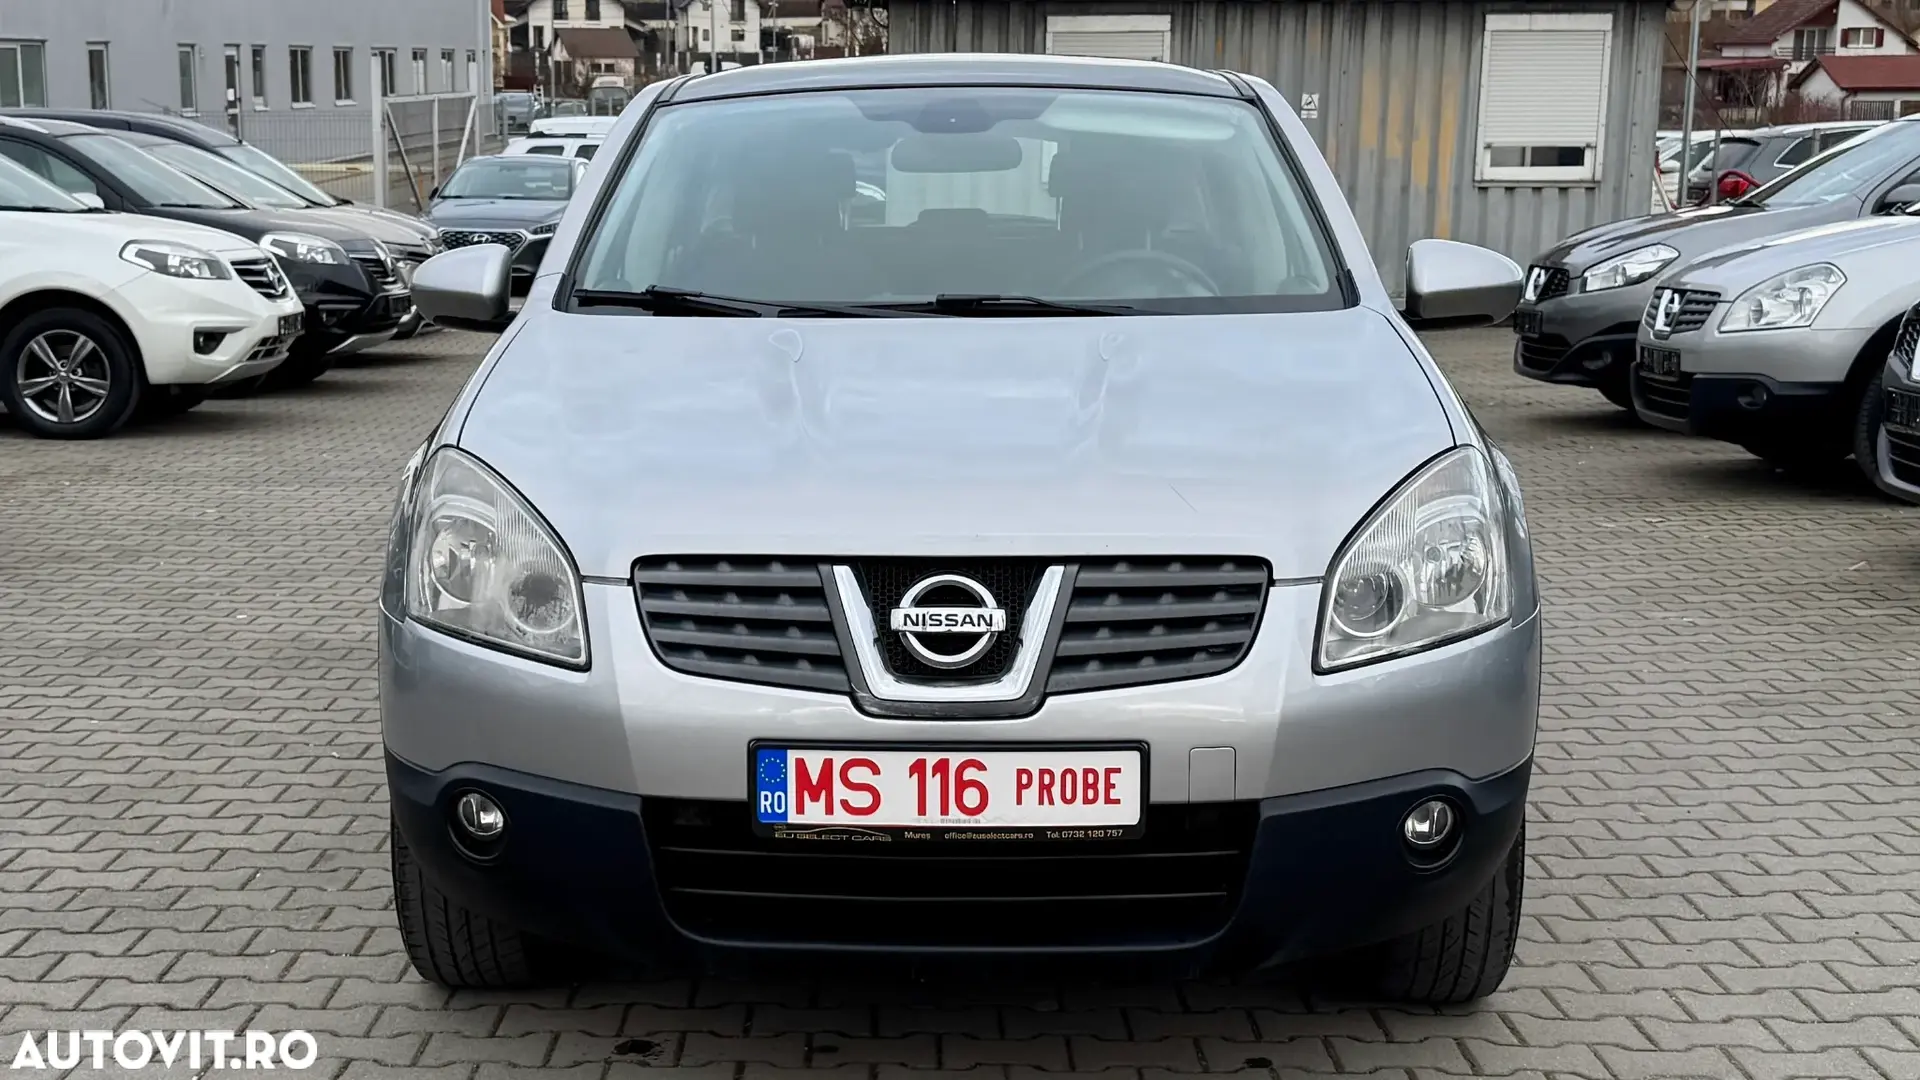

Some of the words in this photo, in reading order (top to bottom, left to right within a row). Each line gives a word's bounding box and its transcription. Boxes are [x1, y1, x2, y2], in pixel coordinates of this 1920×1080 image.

[903, 613, 993, 627] NISSAN
[795, 757, 882, 816] MS
[909, 758, 989, 817] 116
[1016, 767, 1122, 806] PROBE
[760, 791, 786, 814] RO
[797, 833, 849, 841] SELECT
[852, 834, 892, 842] CARS
[1062, 830, 1085, 838] 0732
[1087, 830, 1104, 838] 120
[1106, 829, 1123, 837] 757
